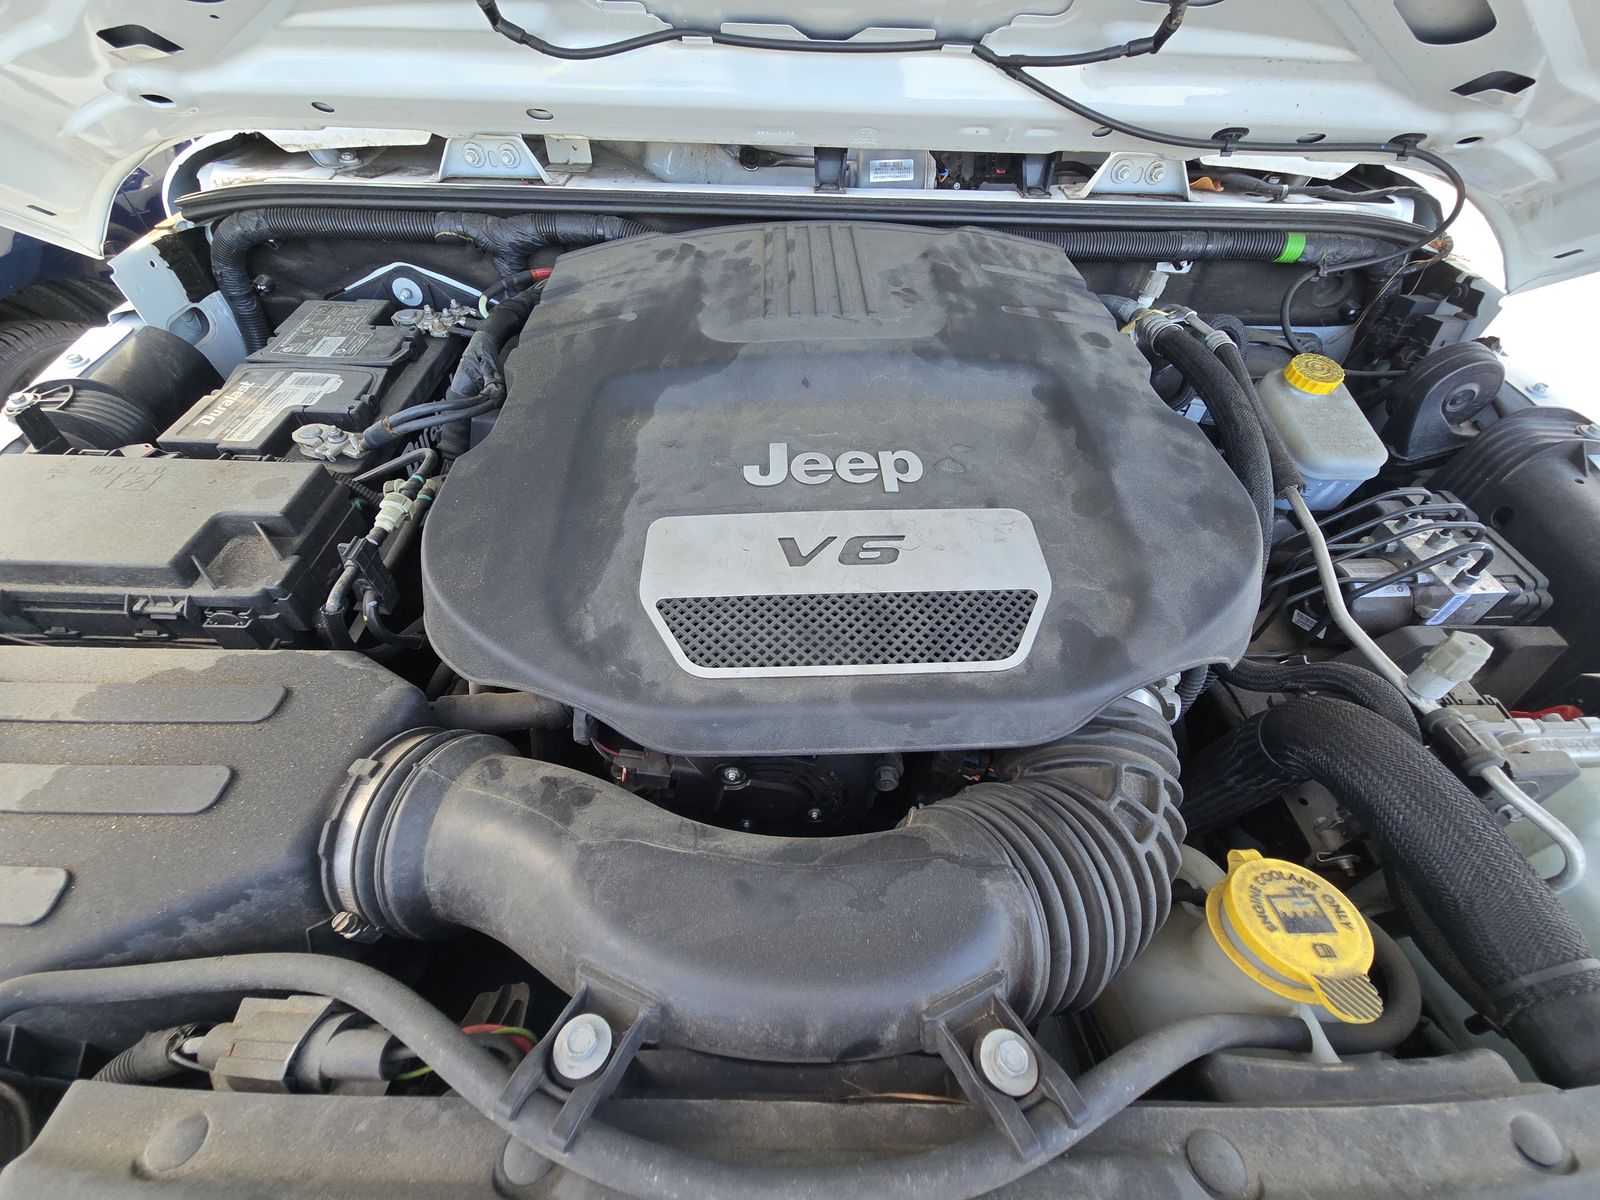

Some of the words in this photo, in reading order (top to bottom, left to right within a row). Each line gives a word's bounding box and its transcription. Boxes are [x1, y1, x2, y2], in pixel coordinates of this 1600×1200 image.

[193, 381, 255, 426] Duralast
[743, 443, 924, 493] Jeep
[777, 535, 906, 567] V6
[1255, 870, 1320, 891] COOLANT
[1249, 884, 1277, 932] ENGINE
[1322, 893, 1354, 931] ONLY
